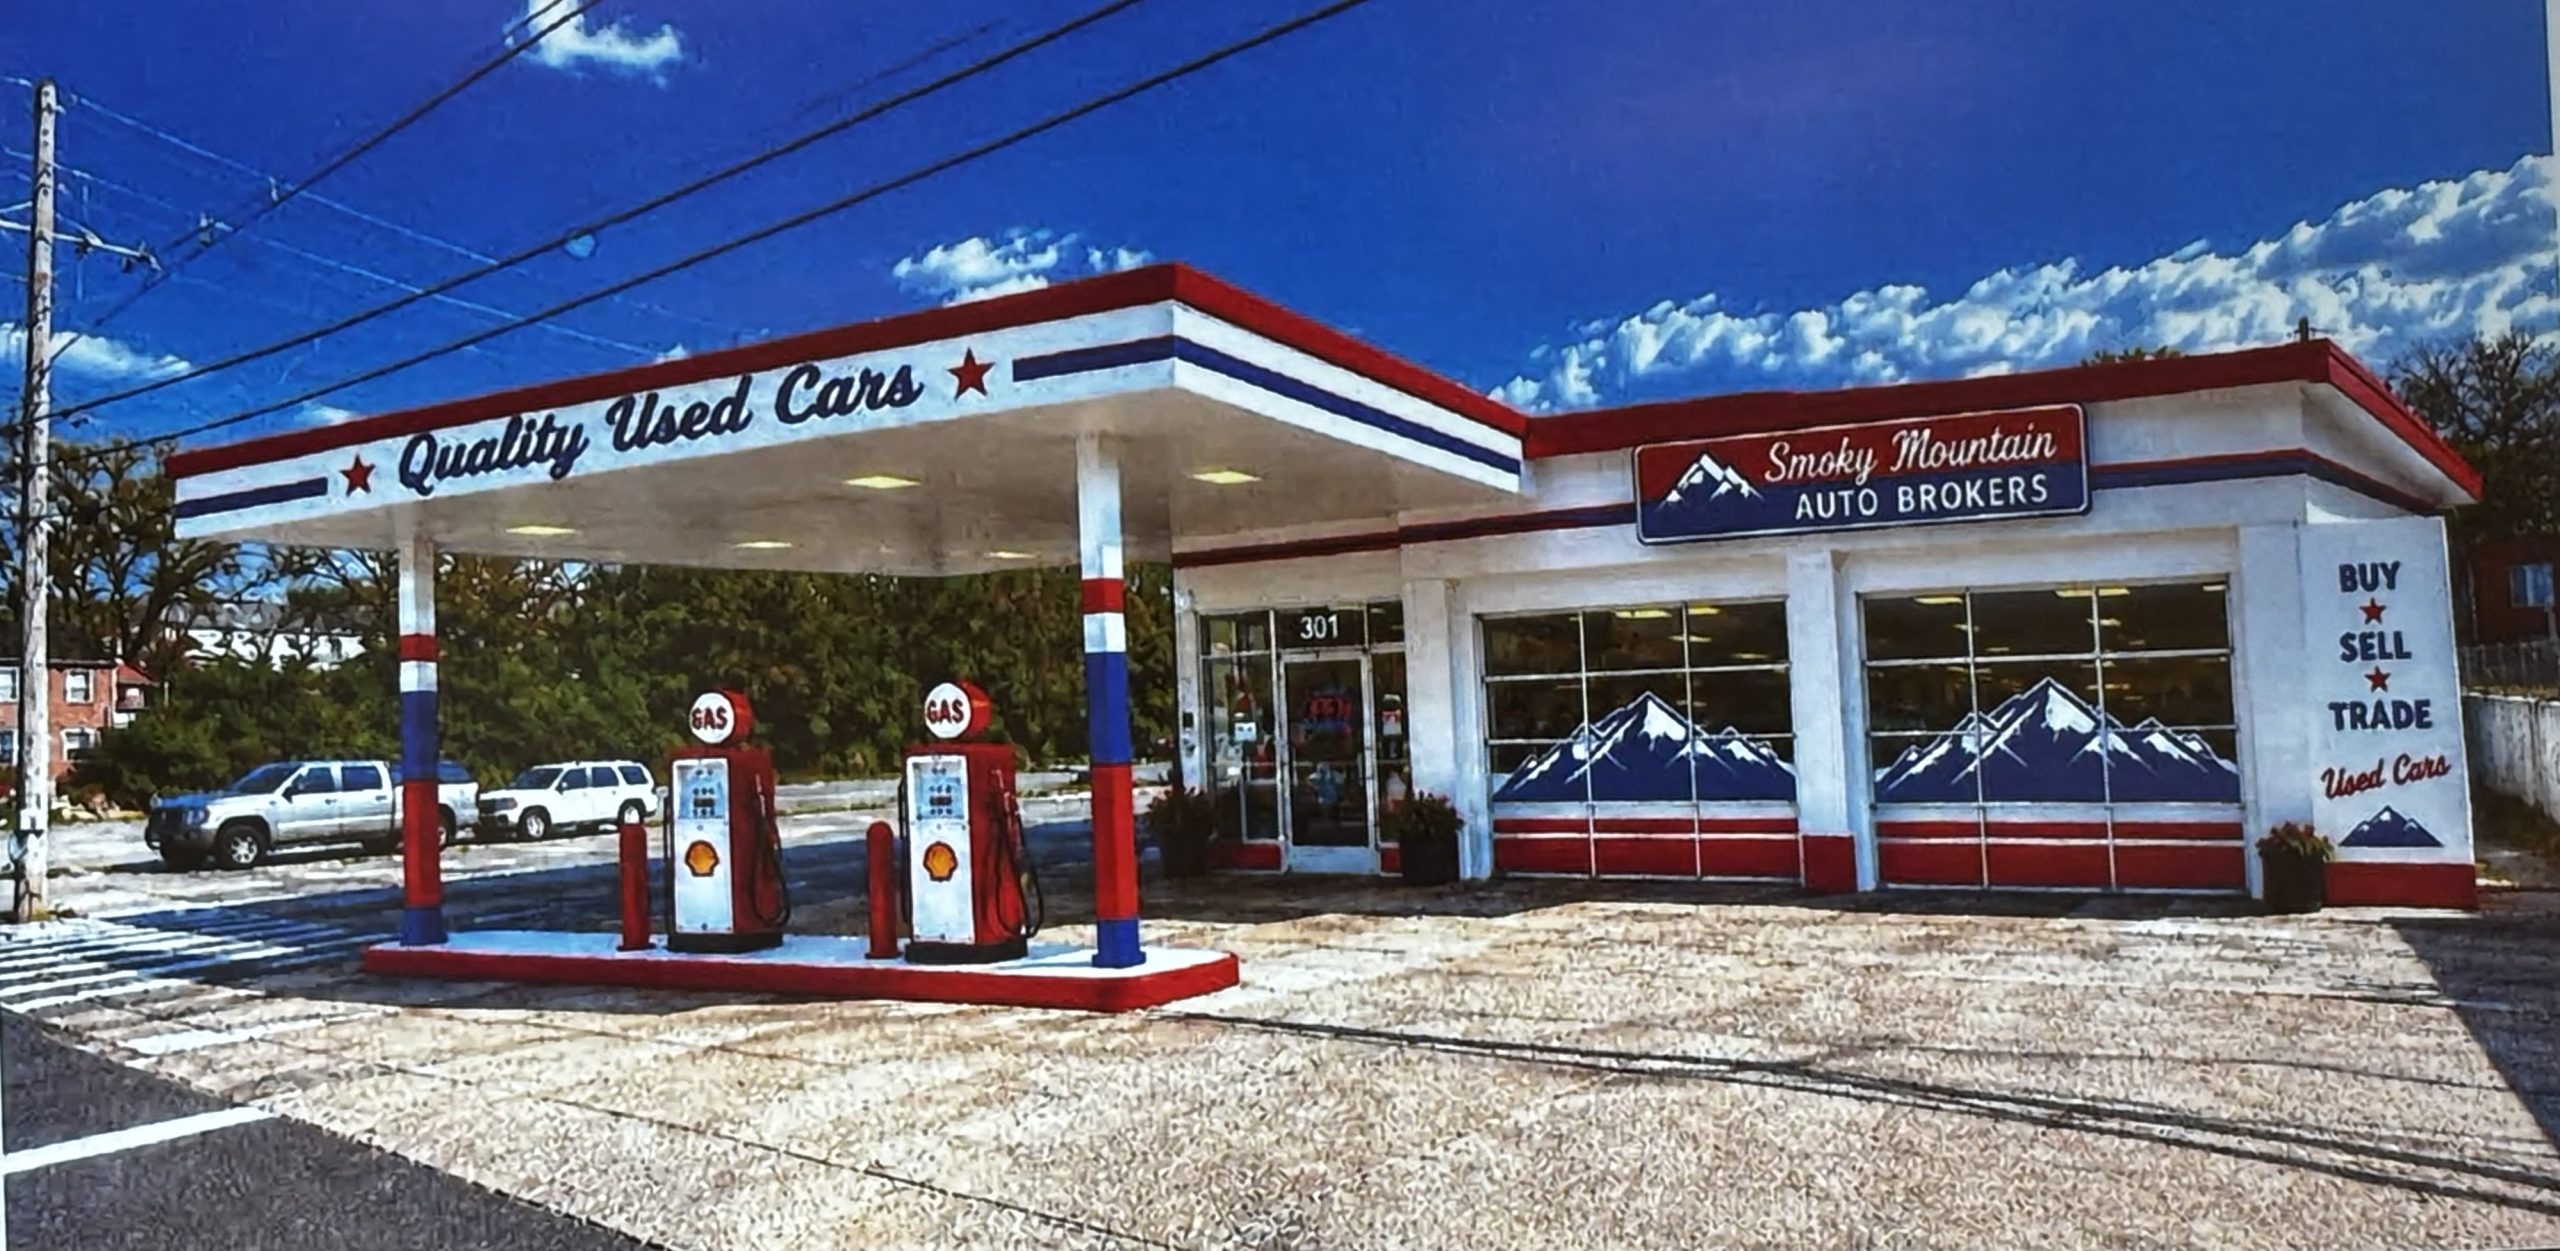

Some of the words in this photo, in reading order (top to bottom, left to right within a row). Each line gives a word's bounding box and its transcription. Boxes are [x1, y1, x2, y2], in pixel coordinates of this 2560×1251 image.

[400, 415, 590, 495] Quality
[606, 374, 753, 452] Used
[775, 362, 925, 425] Cars
[1764, 436, 1877, 485] Smoky
[1890, 423, 2058, 474] Mountain
[1795, 488, 1879, 521] AUTO
[1898, 474, 2049, 514] BROKERS
[2338, 561, 2401, 593] BUY
[1300, 614, 1339, 639] 301
[2339, 630, 2413, 662] SELL
[691, 705, 728, 730] GAS
[926, 698, 965, 724] GAS
[2328, 699, 2434, 731] TRADE
[2320, 758, 2387, 800] Used
[2392, 753, 2453, 787] Cars
